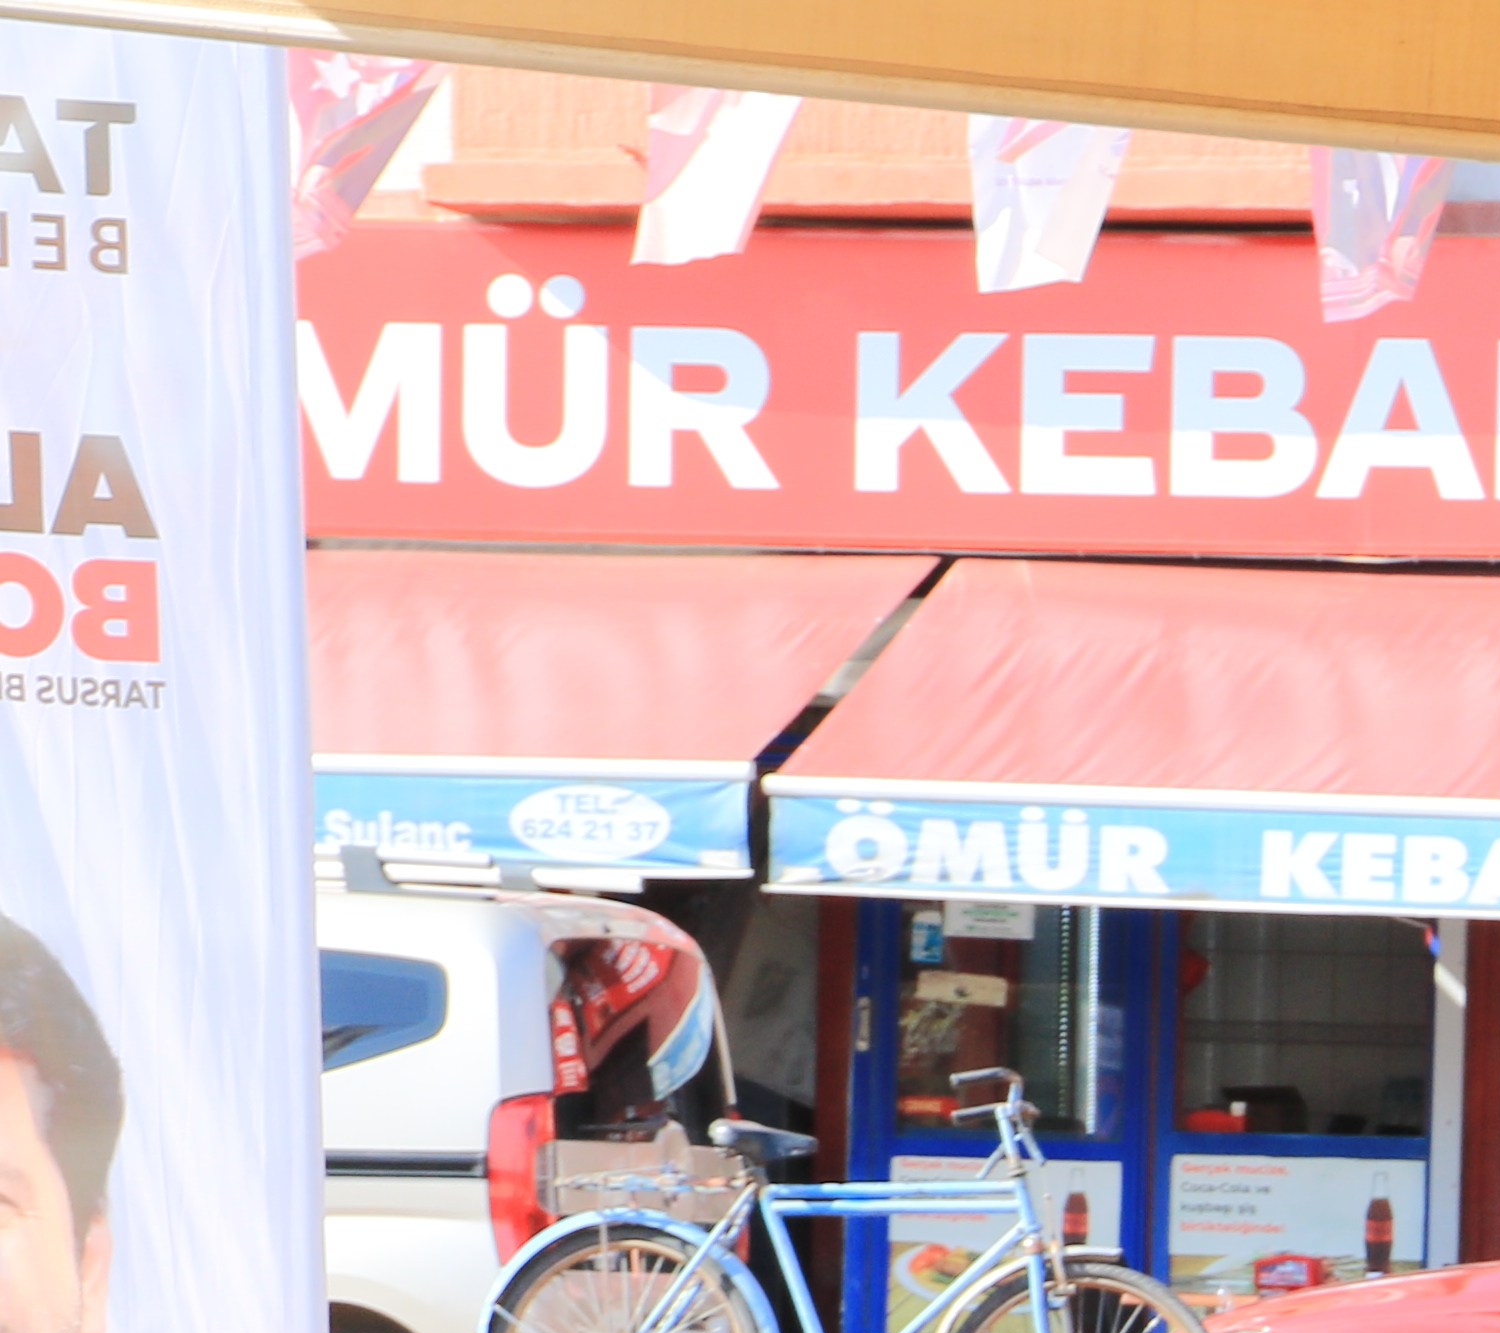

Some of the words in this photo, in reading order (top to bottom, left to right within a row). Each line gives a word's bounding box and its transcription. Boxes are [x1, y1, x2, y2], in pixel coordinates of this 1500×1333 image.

[522, 819, 572, 840] 624
[582, 820, 614, 841] 21
[629, 822, 660, 842] 37
[825, 798, 1170, 894] ÖMÜR
